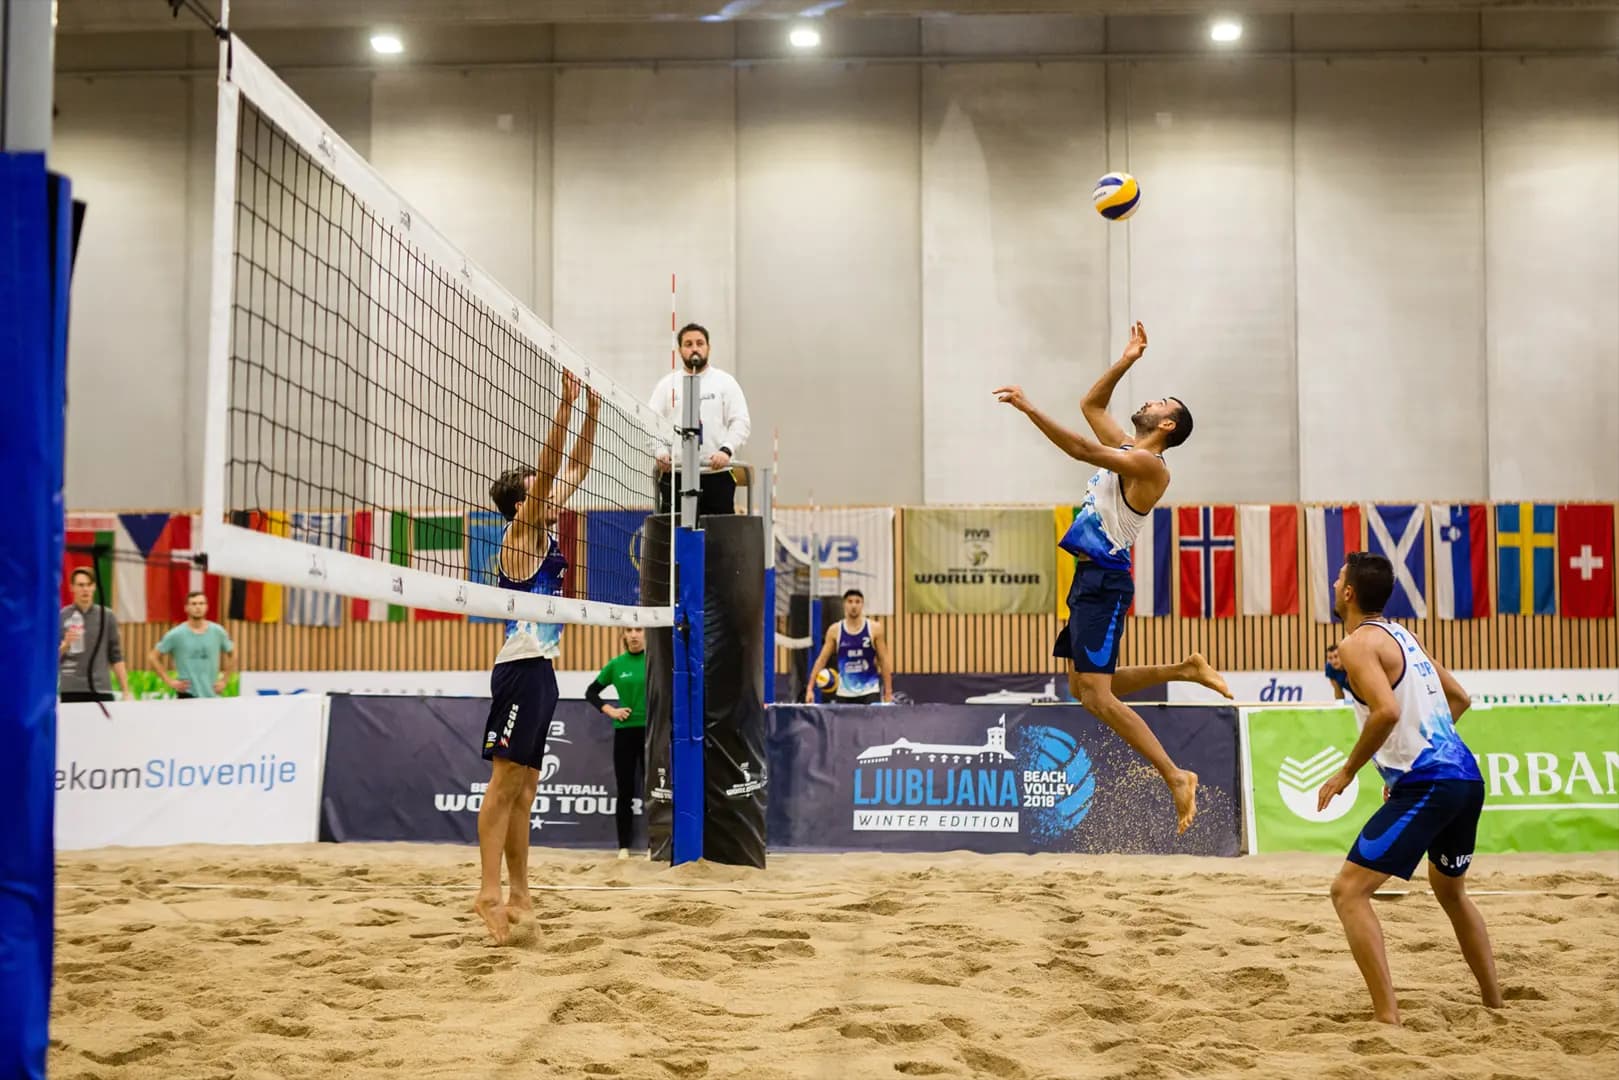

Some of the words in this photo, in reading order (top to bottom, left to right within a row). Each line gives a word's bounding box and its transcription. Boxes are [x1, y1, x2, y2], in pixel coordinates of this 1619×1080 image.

[914, 573, 984, 585] WORLD
[989, 573, 1040, 585] TOUR
[1259, 678, 1303, 702] dm
[1023, 770, 1067, 783] BEACH
[536, 784, 608, 795] LLEYBALL
[853, 767, 1019, 807] LJUBLJANA
[1023, 782, 1075, 796] VOLLEY
[434, 793, 550, 813] WOD
[1023, 795, 1055, 808] 2018
[859, 815, 929, 827] WINTER
[939, 816, 1014, 828] EDITION
